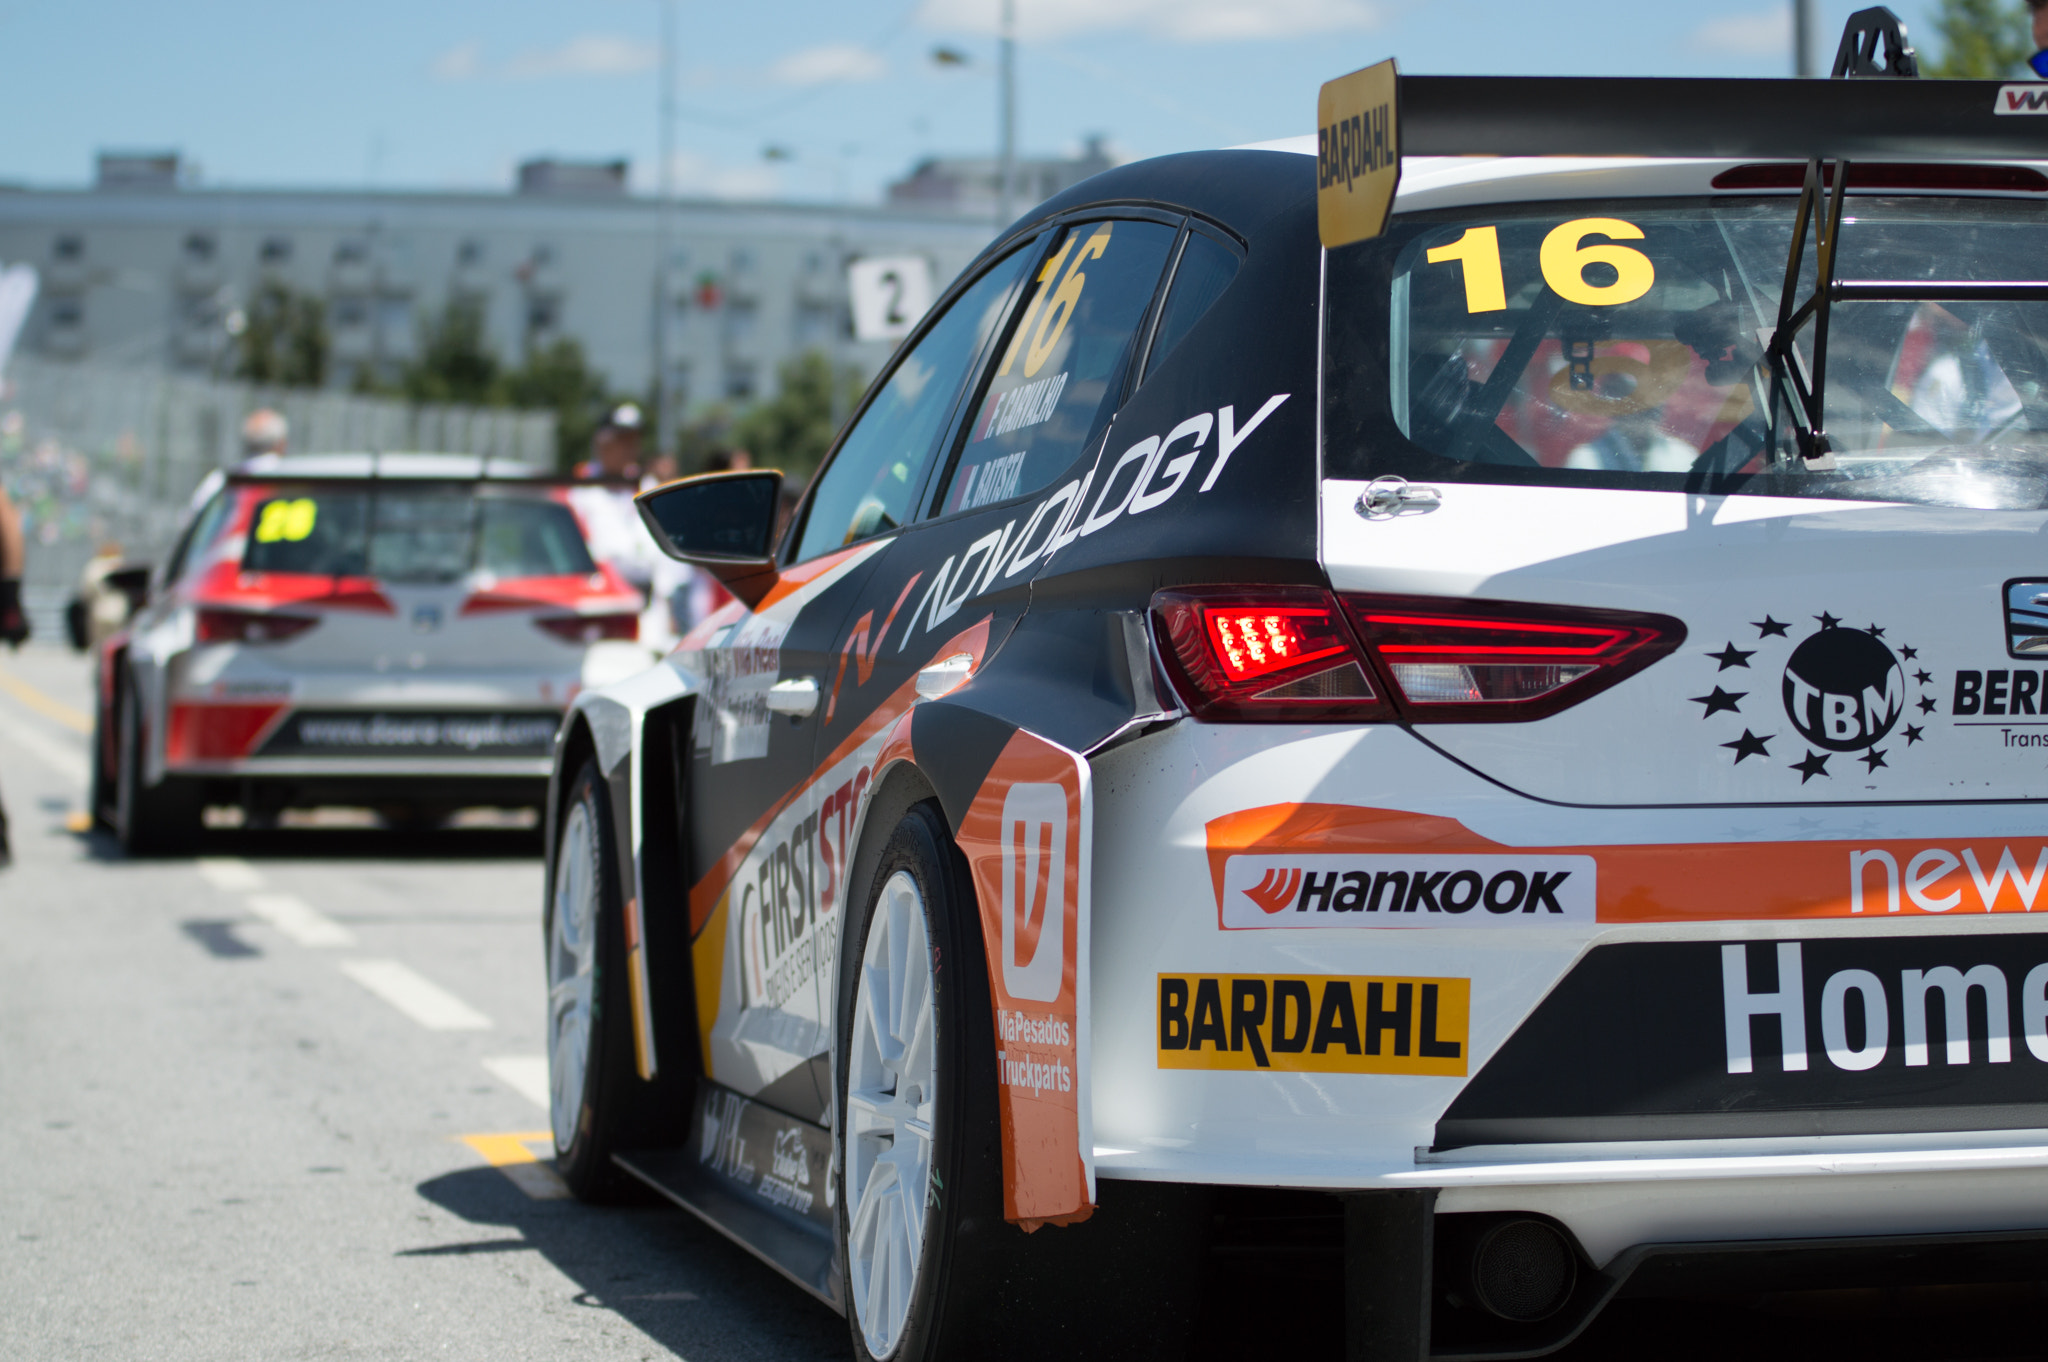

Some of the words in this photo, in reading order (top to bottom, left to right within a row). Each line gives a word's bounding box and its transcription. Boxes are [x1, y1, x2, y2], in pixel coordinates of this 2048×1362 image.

[1319, 103, 1394, 193] BARDAHL
[879, 270, 906, 325] 2
[1427, 217, 1655, 314] 16
[998, 221, 1113, 378] 16
[996, 371, 1069, 436] CARVALHO
[971, 451, 1027, 508] BATISTA
[1785, 663, 1905, 741] TBM
[1952, 670, 2048, 715] BER
[1850, 845, 2048, 914] new
[997, 1009, 1069, 1046] ViaPesados
[1160, 978, 1461, 1067] BARDAHL
[998, 1050, 1071, 1097] Truckparts
